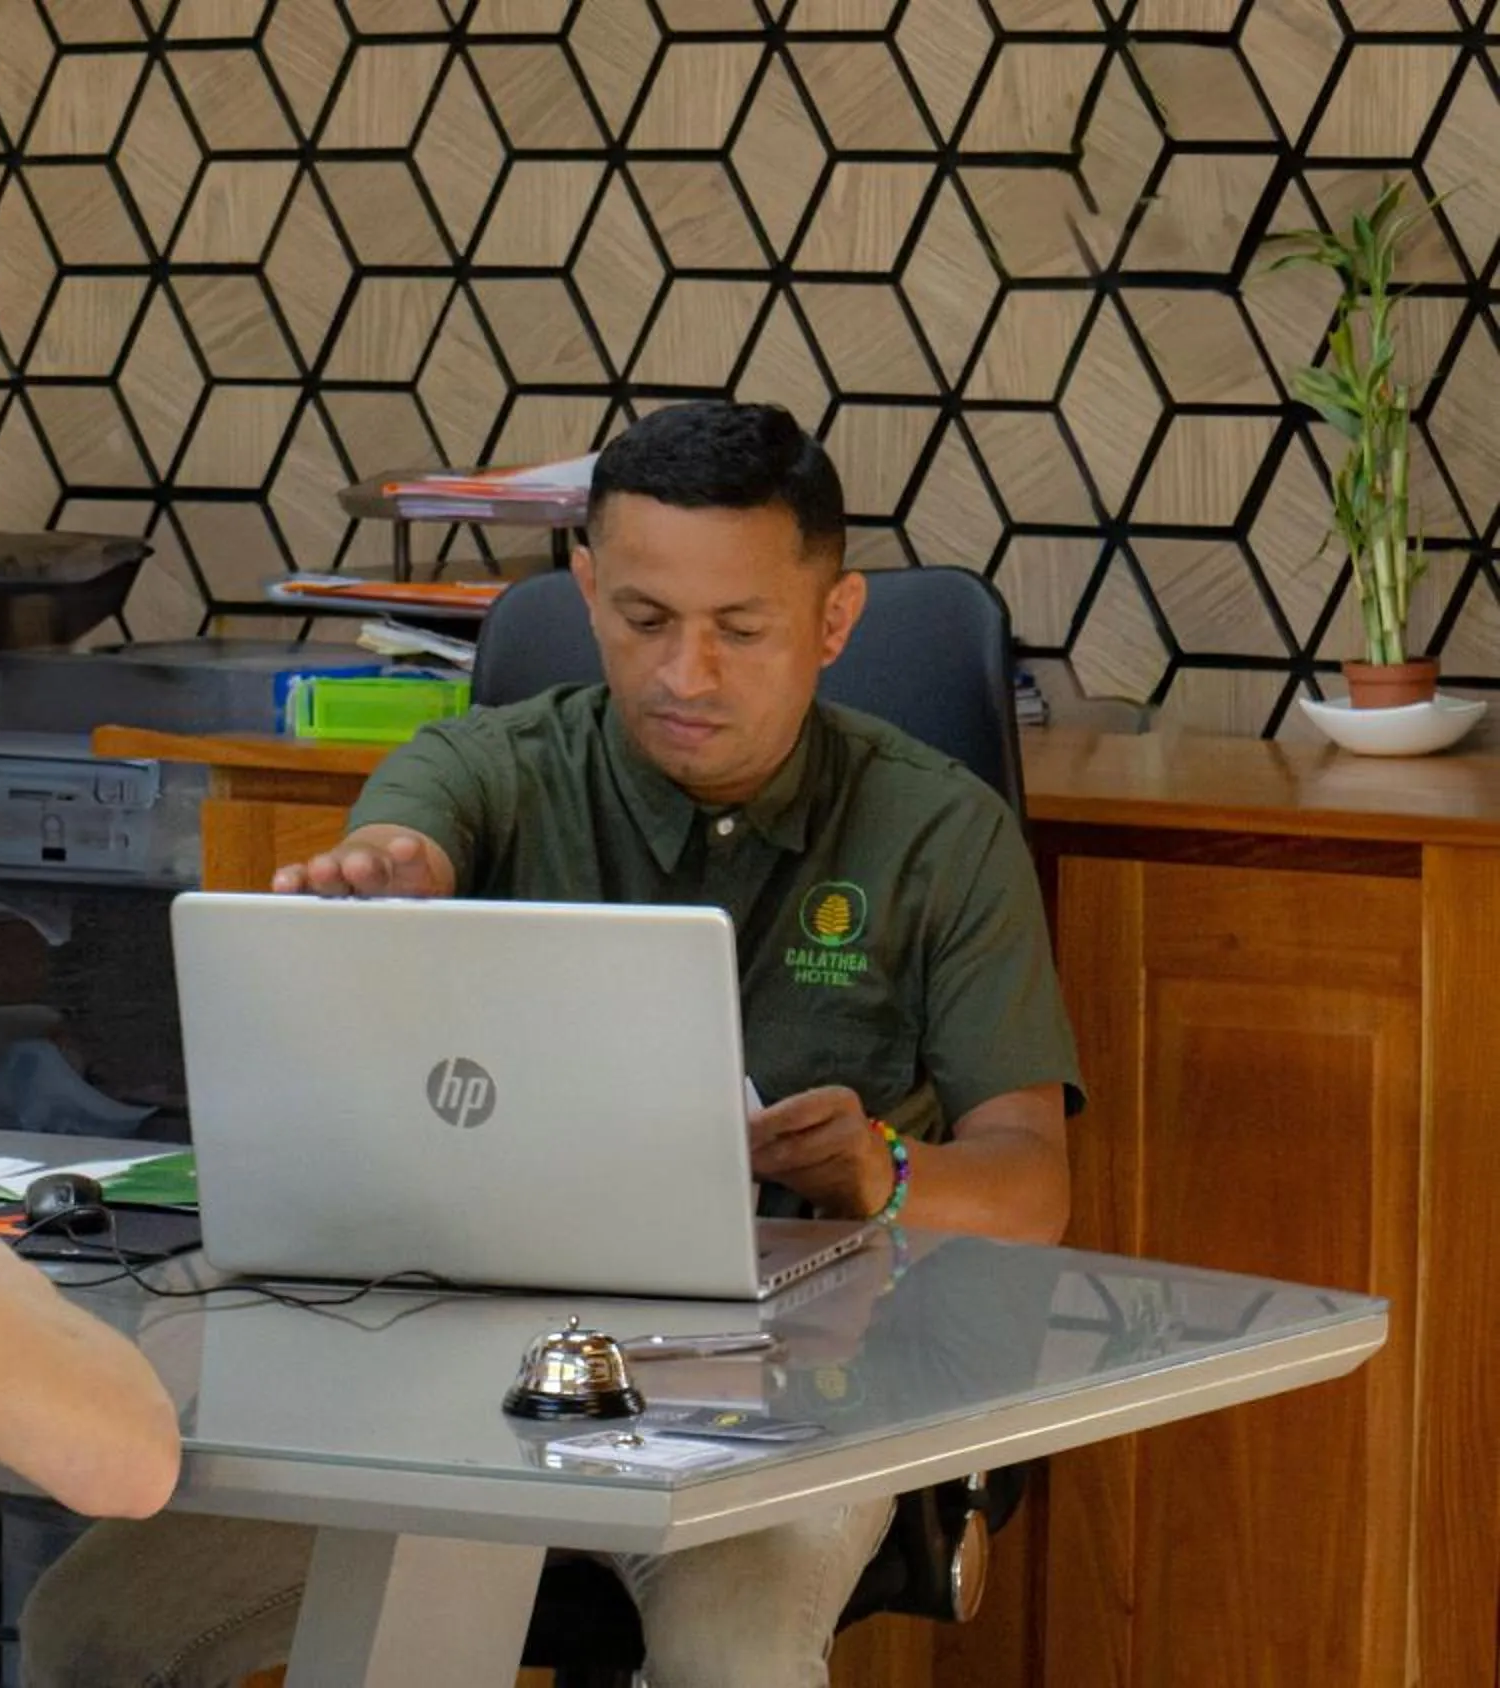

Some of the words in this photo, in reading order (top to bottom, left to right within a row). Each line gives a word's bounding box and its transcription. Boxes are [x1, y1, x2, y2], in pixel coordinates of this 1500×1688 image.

[785, 947, 868, 972] CALATHEA
[794, 969, 855, 986] HOTEL
[436, 1057, 488, 1129] hp
